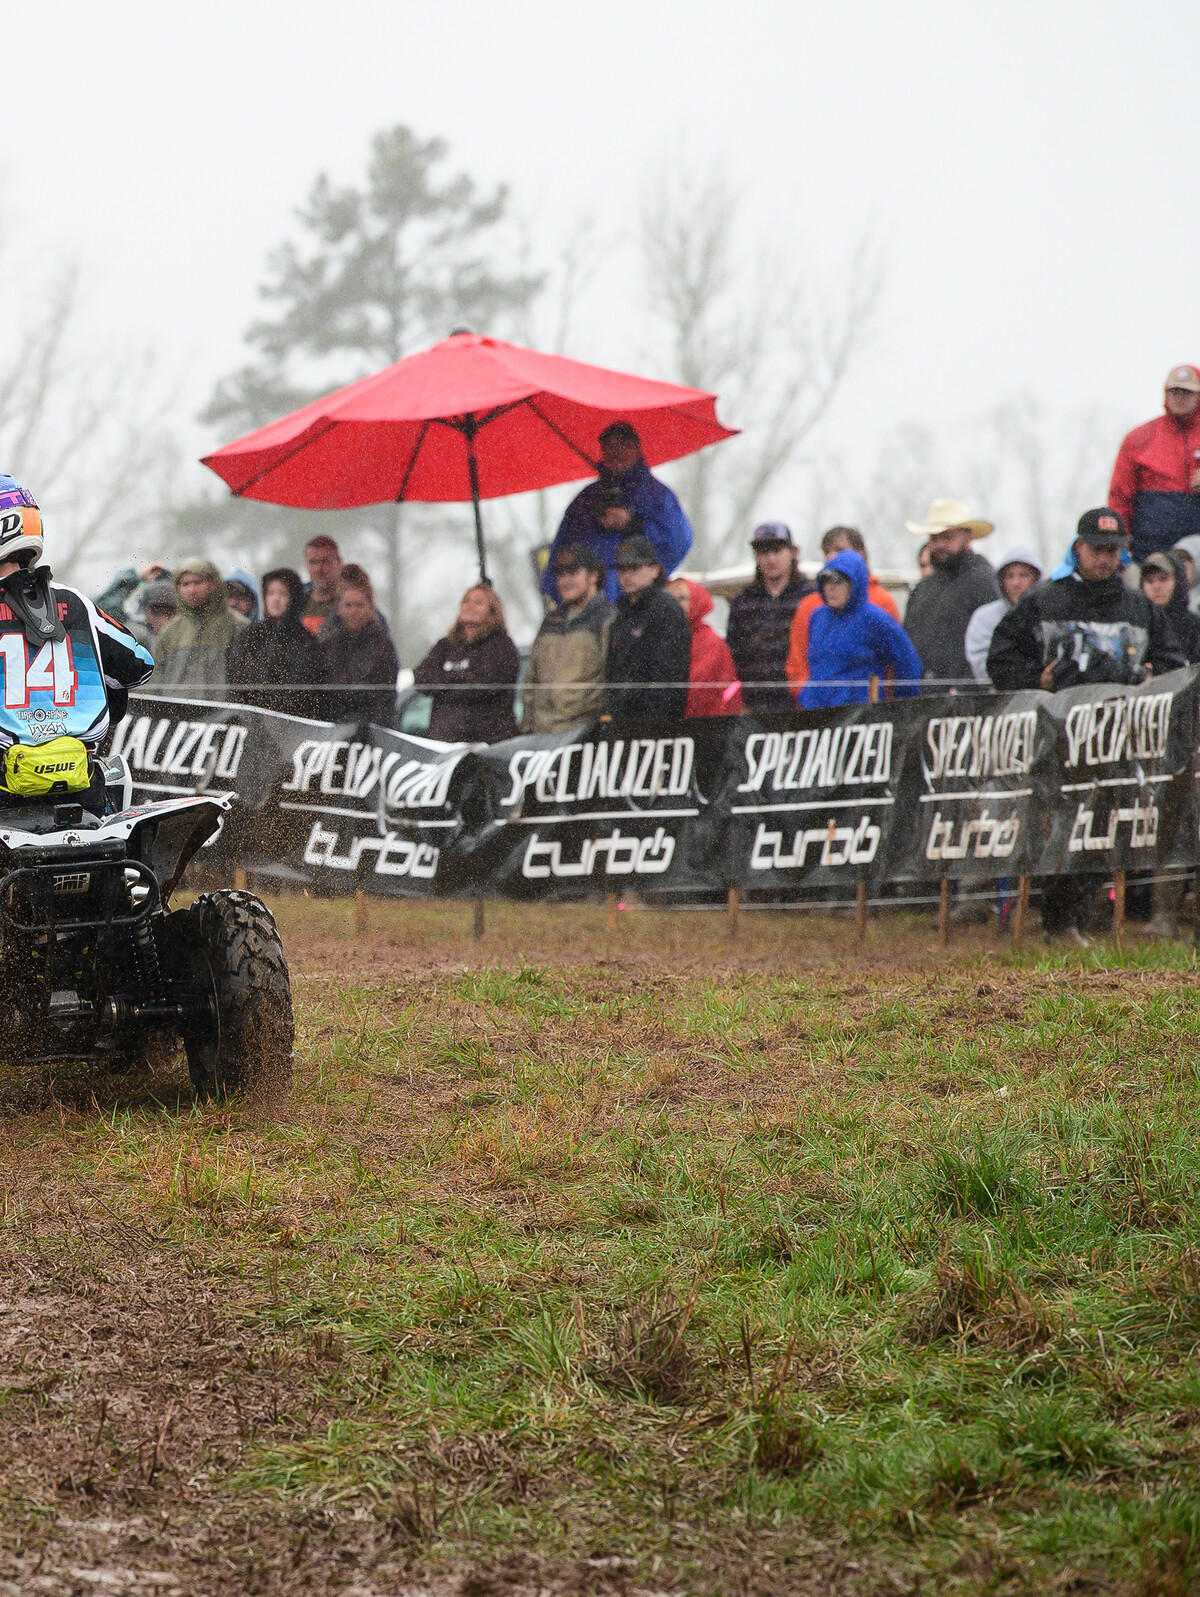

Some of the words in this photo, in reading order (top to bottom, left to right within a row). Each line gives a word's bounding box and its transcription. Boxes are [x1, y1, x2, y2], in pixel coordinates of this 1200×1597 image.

[34, 762, 76, 774] USWE
[108, 715, 249, 779] IALIZED
[499, 737, 695, 806] SPECIALIZED
[737, 722, 894, 793] SPECIALIZED
[304, 821, 440, 878] turbo
[522, 827, 676, 878] turbo
[751, 815, 881, 870] turbo
[926, 809, 1020, 860] turbo
